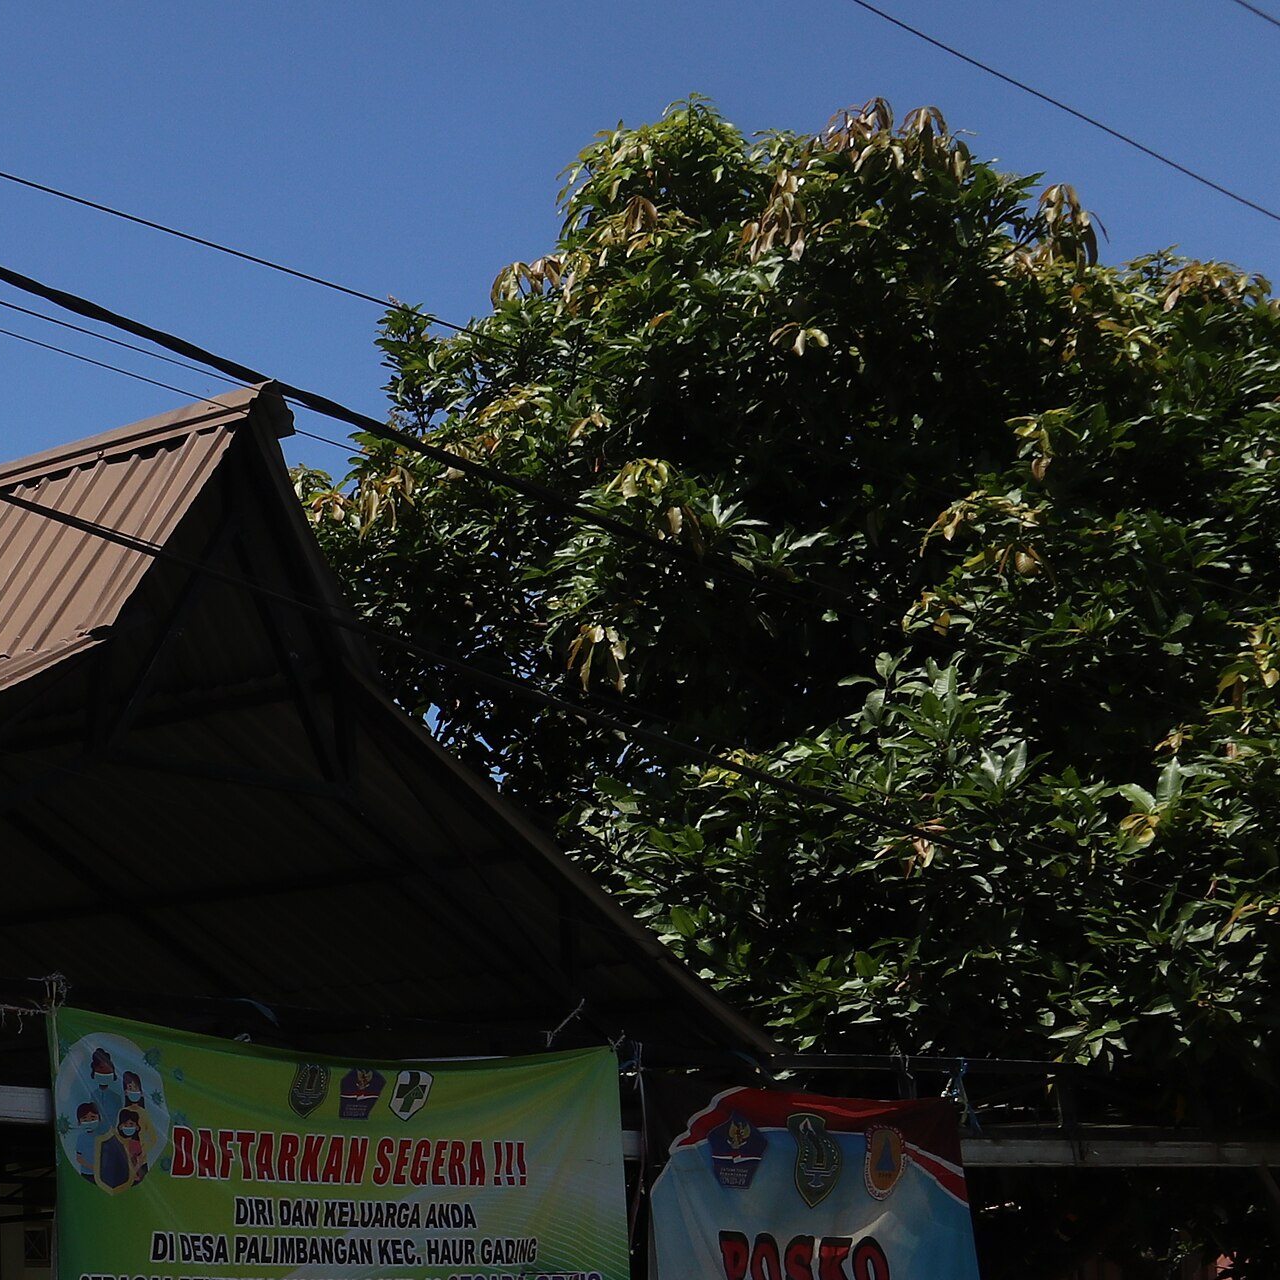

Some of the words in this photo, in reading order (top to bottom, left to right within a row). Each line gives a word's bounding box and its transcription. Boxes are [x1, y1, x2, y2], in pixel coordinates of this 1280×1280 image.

[170, 1125, 369, 1184] DAFTARKAN
[372, 1136, 486, 1187] SEGERA
[235, 1197, 274, 1226] DIRI
[279, 1199, 319, 1228] DAN
[323, 1201, 421, 1229] KELUARGA
[425, 1203, 477, 1229] ANDA
[151, 1232, 175, 1262] DI
[179, 1233, 229, 1263] DESA
[234, 1235, 373, 1265] PALIMBANGAN
[378, 1238, 422, 1265] KEC.
[426, 1238, 477, 1265] HAUR
[480, 1238, 537, 1265] GADING
